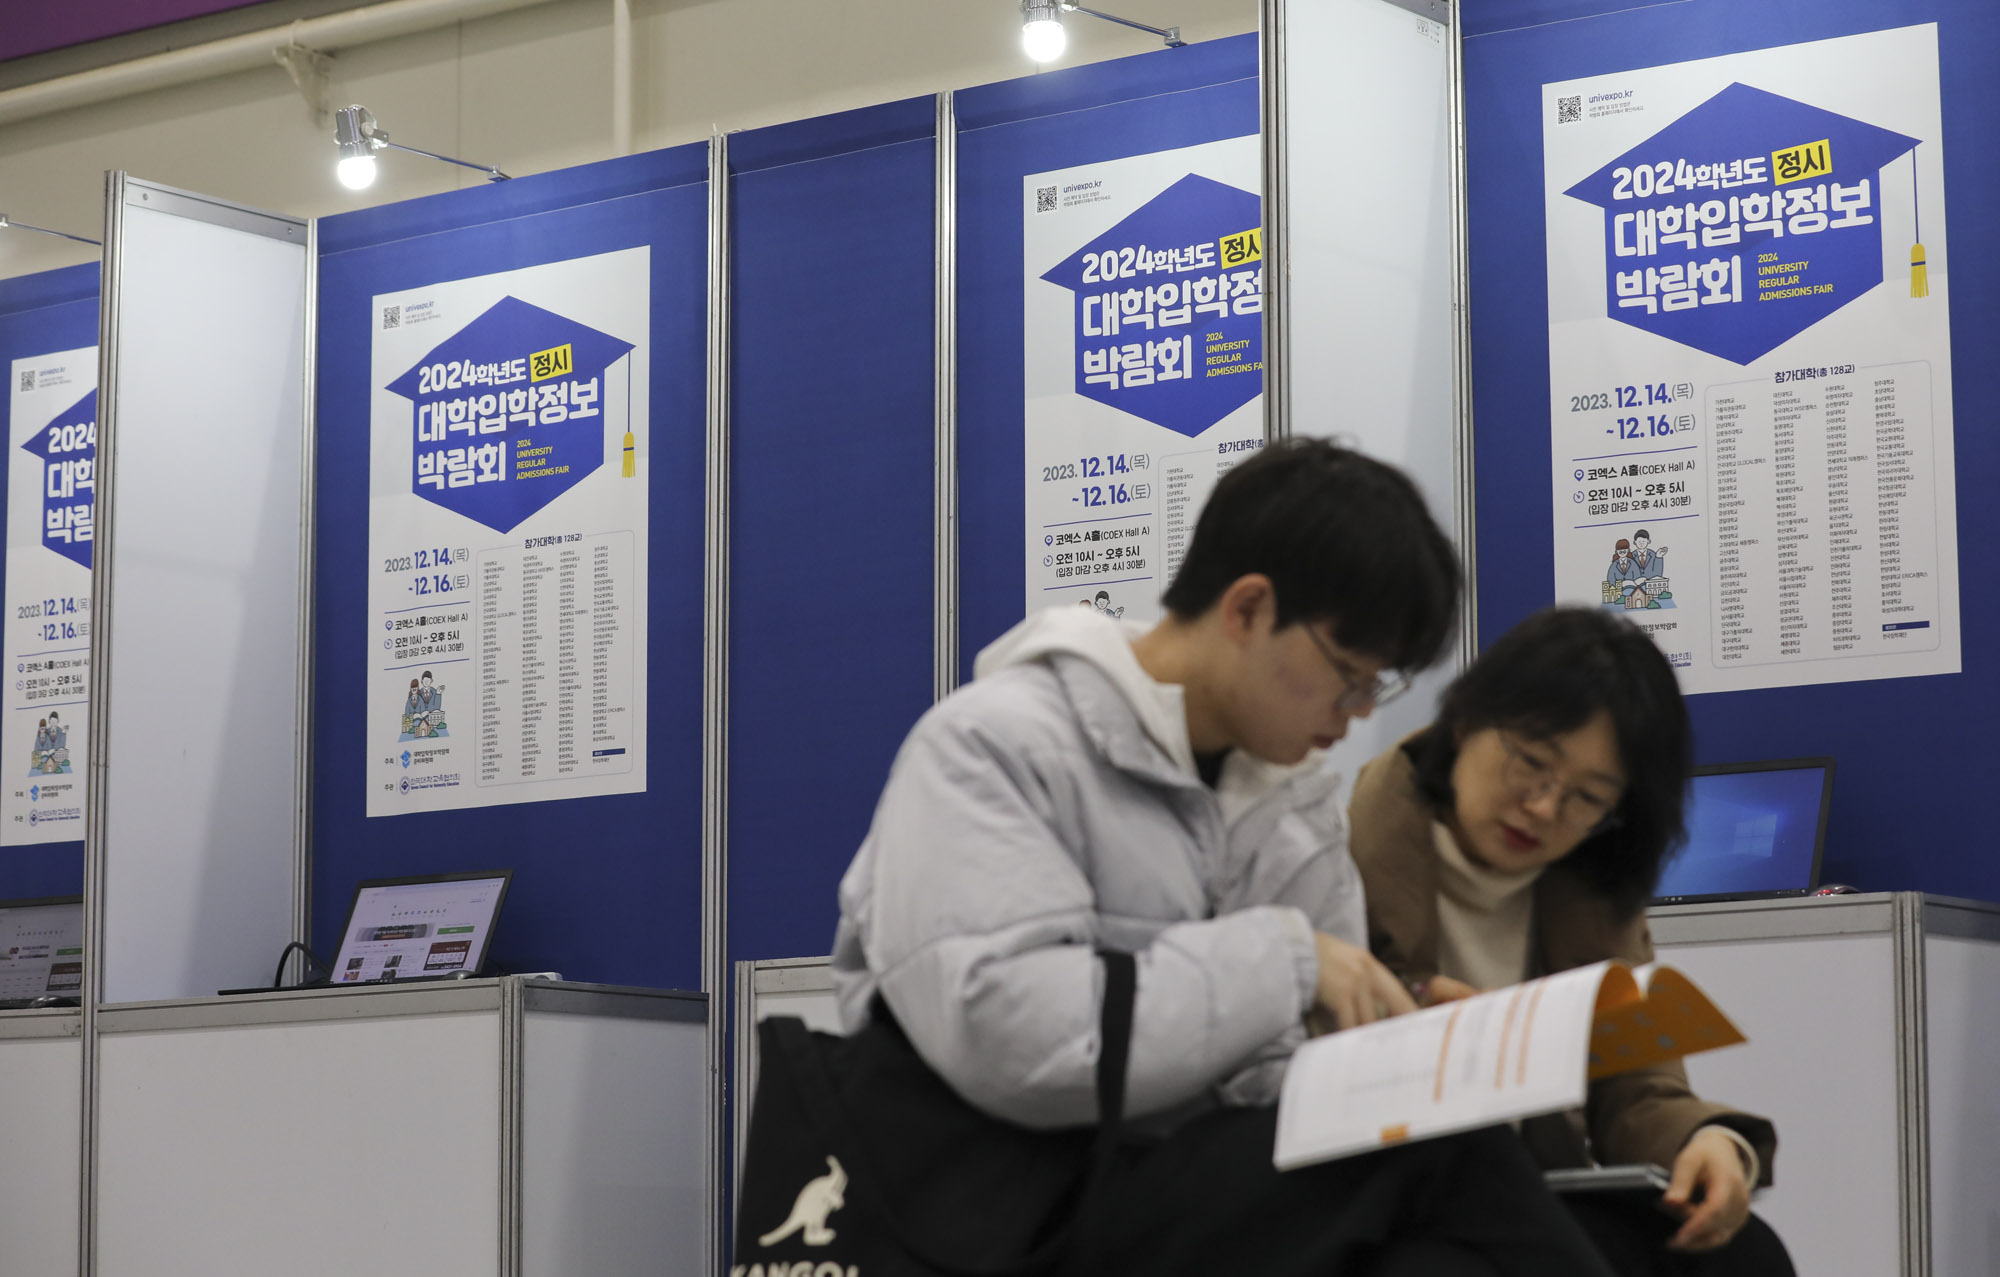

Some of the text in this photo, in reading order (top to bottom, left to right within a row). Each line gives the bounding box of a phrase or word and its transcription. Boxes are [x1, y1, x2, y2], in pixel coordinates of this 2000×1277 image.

[1588, 90, 1633, 103] univexpo.kr
[1612, 143, 1826, 200] 2024학년도 정시
[1063, 180, 1103, 194] univexpo.kr
[1613, 178, 1874, 257] 대학입학정보
[1081, 242, 1216, 284] 2024학년도
[1757, 252, 1779, 263] 2024
[1758, 261, 1809, 276] UNIVERSITY
[1615, 254, 1743, 315] 박람회
[1758, 274, 1800, 289] REGULAR
[1759, 284, 1834, 302] ADMISSIONS FAIR
[1205, 332, 1224, 342] 2024
[1205, 339, 1251, 354] UNIVERSITY
[1083, 335, 1192, 390] 박람회
[1205, 353, 1242, 366] REGULAR
[418, 349, 569, 395] 2024학년도 정시
[1205, 362, 1263, 378] ADMISSIONS FA
[1774, 364, 1856, 383] 참가대학(총 128교)
[418, 377, 600, 443] 대학입학정보
[1571, 393, 1612, 412] 2023.
[516, 439, 532, 448] 2024
[516, 446, 554, 459] UNIVERSITY
[418, 441, 507, 490] 박람회
[516, 458, 547, 469] REGULAR
[516, 465, 570, 480] ADMISSIONS FAIR
[1043, 463, 1078, 482] 2023.
[1587, 460, 1696, 481] 코엑스 A홀(COEX Hall A)
[1588, 488, 1609, 501] 오전
[1611, 486, 1633, 499] 10시
[1644, 483, 1666, 496] 오후
[1669, 481, 1685, 493] 5시
[1588, 495, 1692, 515] (입장 마감 오후 4시 30분)
[524, 533, 583, 549] 참가대학(총 128교)
[1055, 526, 1150, 545] 코엑스 A홀(COEX Hall A)
[1055, 553, 1074, 565] 오전
[1075, 550, 1095, 562] 10시
[1105, 548, 1124, 560] 오후
[1125, 546, 1140, 557] 5시
[384, 557, 413, 573] 2023.
[1055, 558, 1146, 578] (입장 마감 오후 4시 30분)
[17, 605, 42, 619] 2023.
[395, 613, 469, 630] 코엑스 A홀(COEX Hall A)
[395, 637, 409, 648] 오전
[409, 634, 423, 646] 10시
[430, 632, 446, 644] 오후
[447, 630, 461, 642] 5시
[395, 647, 409, 661] (입장
[420, 644, 434, 656] 오후
[435, 643, 447, 654] 4시
[448, 642, 465, 653] 30분)
[25, 680, 39, 690] 오전
[57, 676, 70, 686] 오후
[71, 674, 83, 685] 5시
